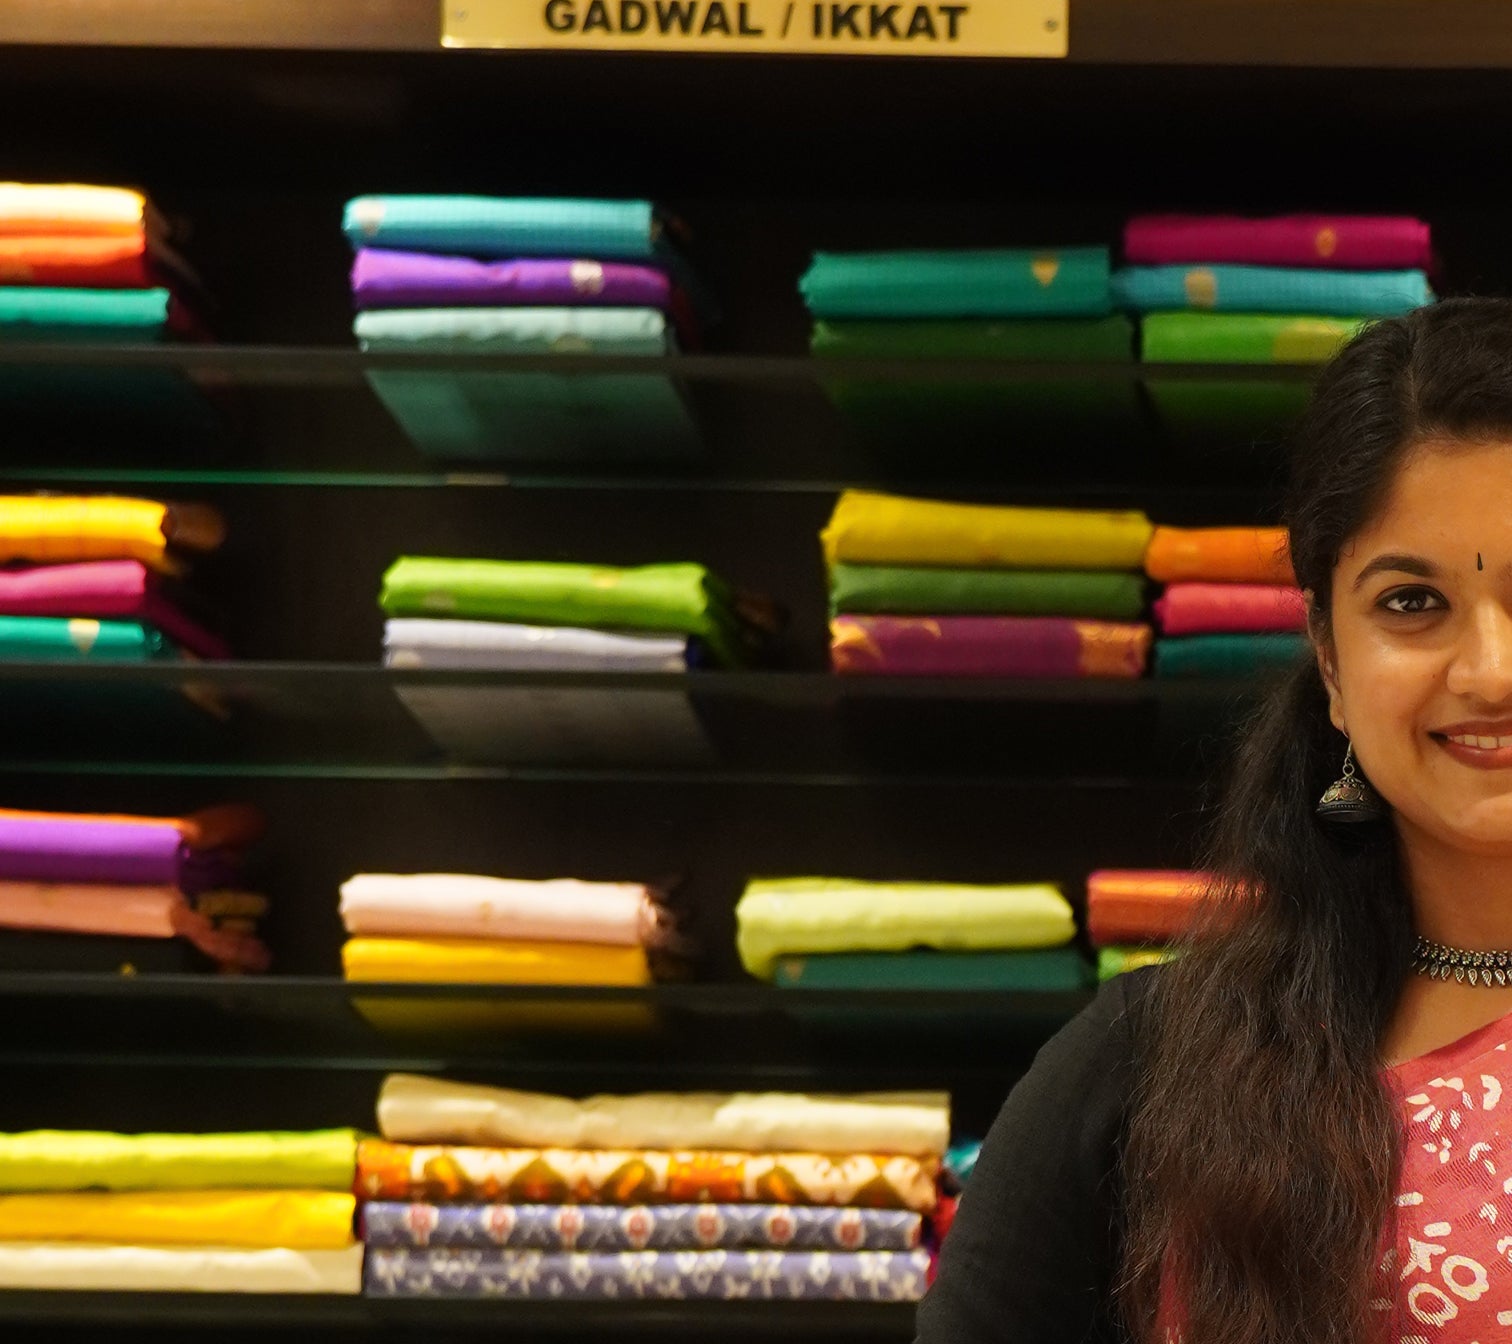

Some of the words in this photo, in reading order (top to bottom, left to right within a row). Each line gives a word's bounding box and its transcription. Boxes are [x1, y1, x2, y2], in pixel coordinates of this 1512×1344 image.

[543, 0, 763, 37] GADWAL
[780, 3, 793, 39] /
[812, 5, 969, 42] IKKAT
